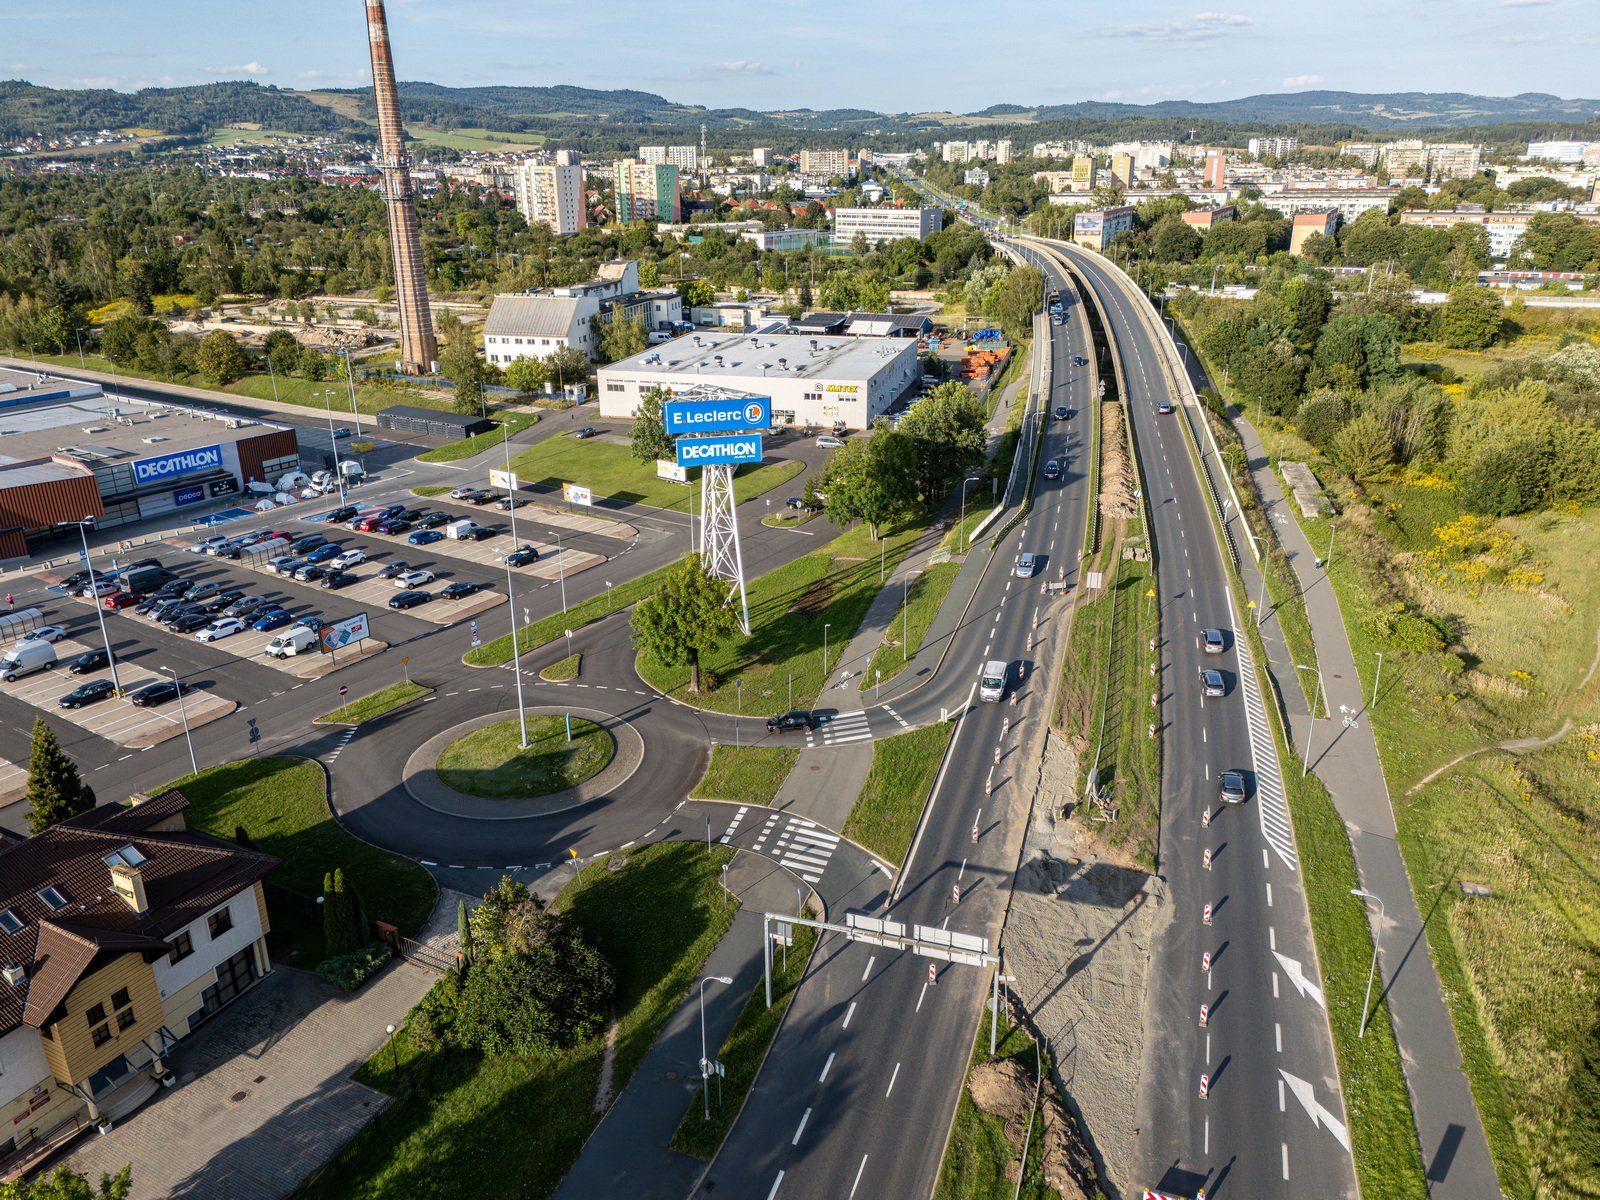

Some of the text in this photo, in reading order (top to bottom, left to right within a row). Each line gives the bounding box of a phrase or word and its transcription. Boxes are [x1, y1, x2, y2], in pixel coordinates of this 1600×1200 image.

[673, 410, 742, 425] E.Leclerc
[682, 441, 756, 459] DECATHLON
[137, 449, 218, 478] DECATHLON
[178, 491, 201, 501] pepco
